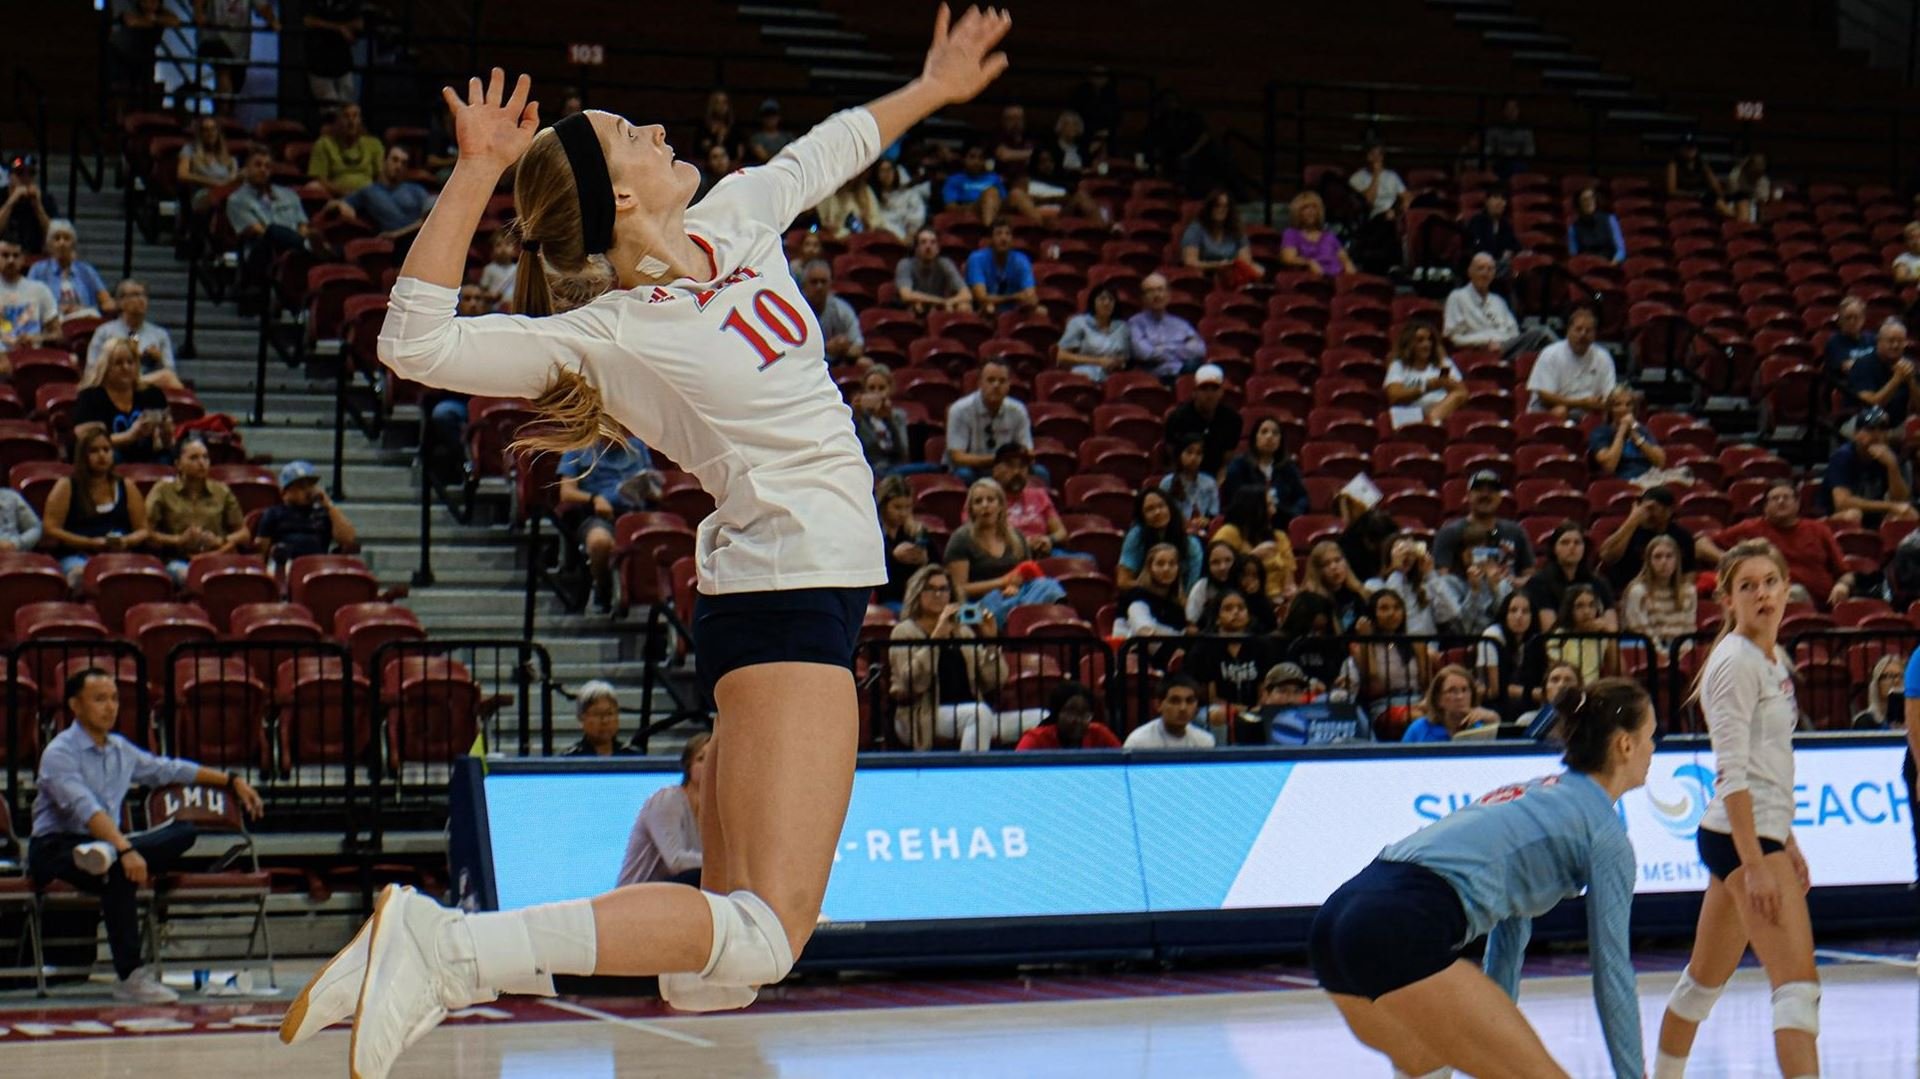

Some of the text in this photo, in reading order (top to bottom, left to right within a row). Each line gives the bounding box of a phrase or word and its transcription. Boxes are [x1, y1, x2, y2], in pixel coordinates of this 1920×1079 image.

[571, 44, 603, 65] 103
[1737, 101, 1763, 120] 102
[718, 288, 808, 372] 10
[164, 785, 224, 816] LMU
[1792, 781, 1909, 827] EACH
[834, 825, 1030, 863] -REHAB
[1643, 861, 1703, 882] MENT
